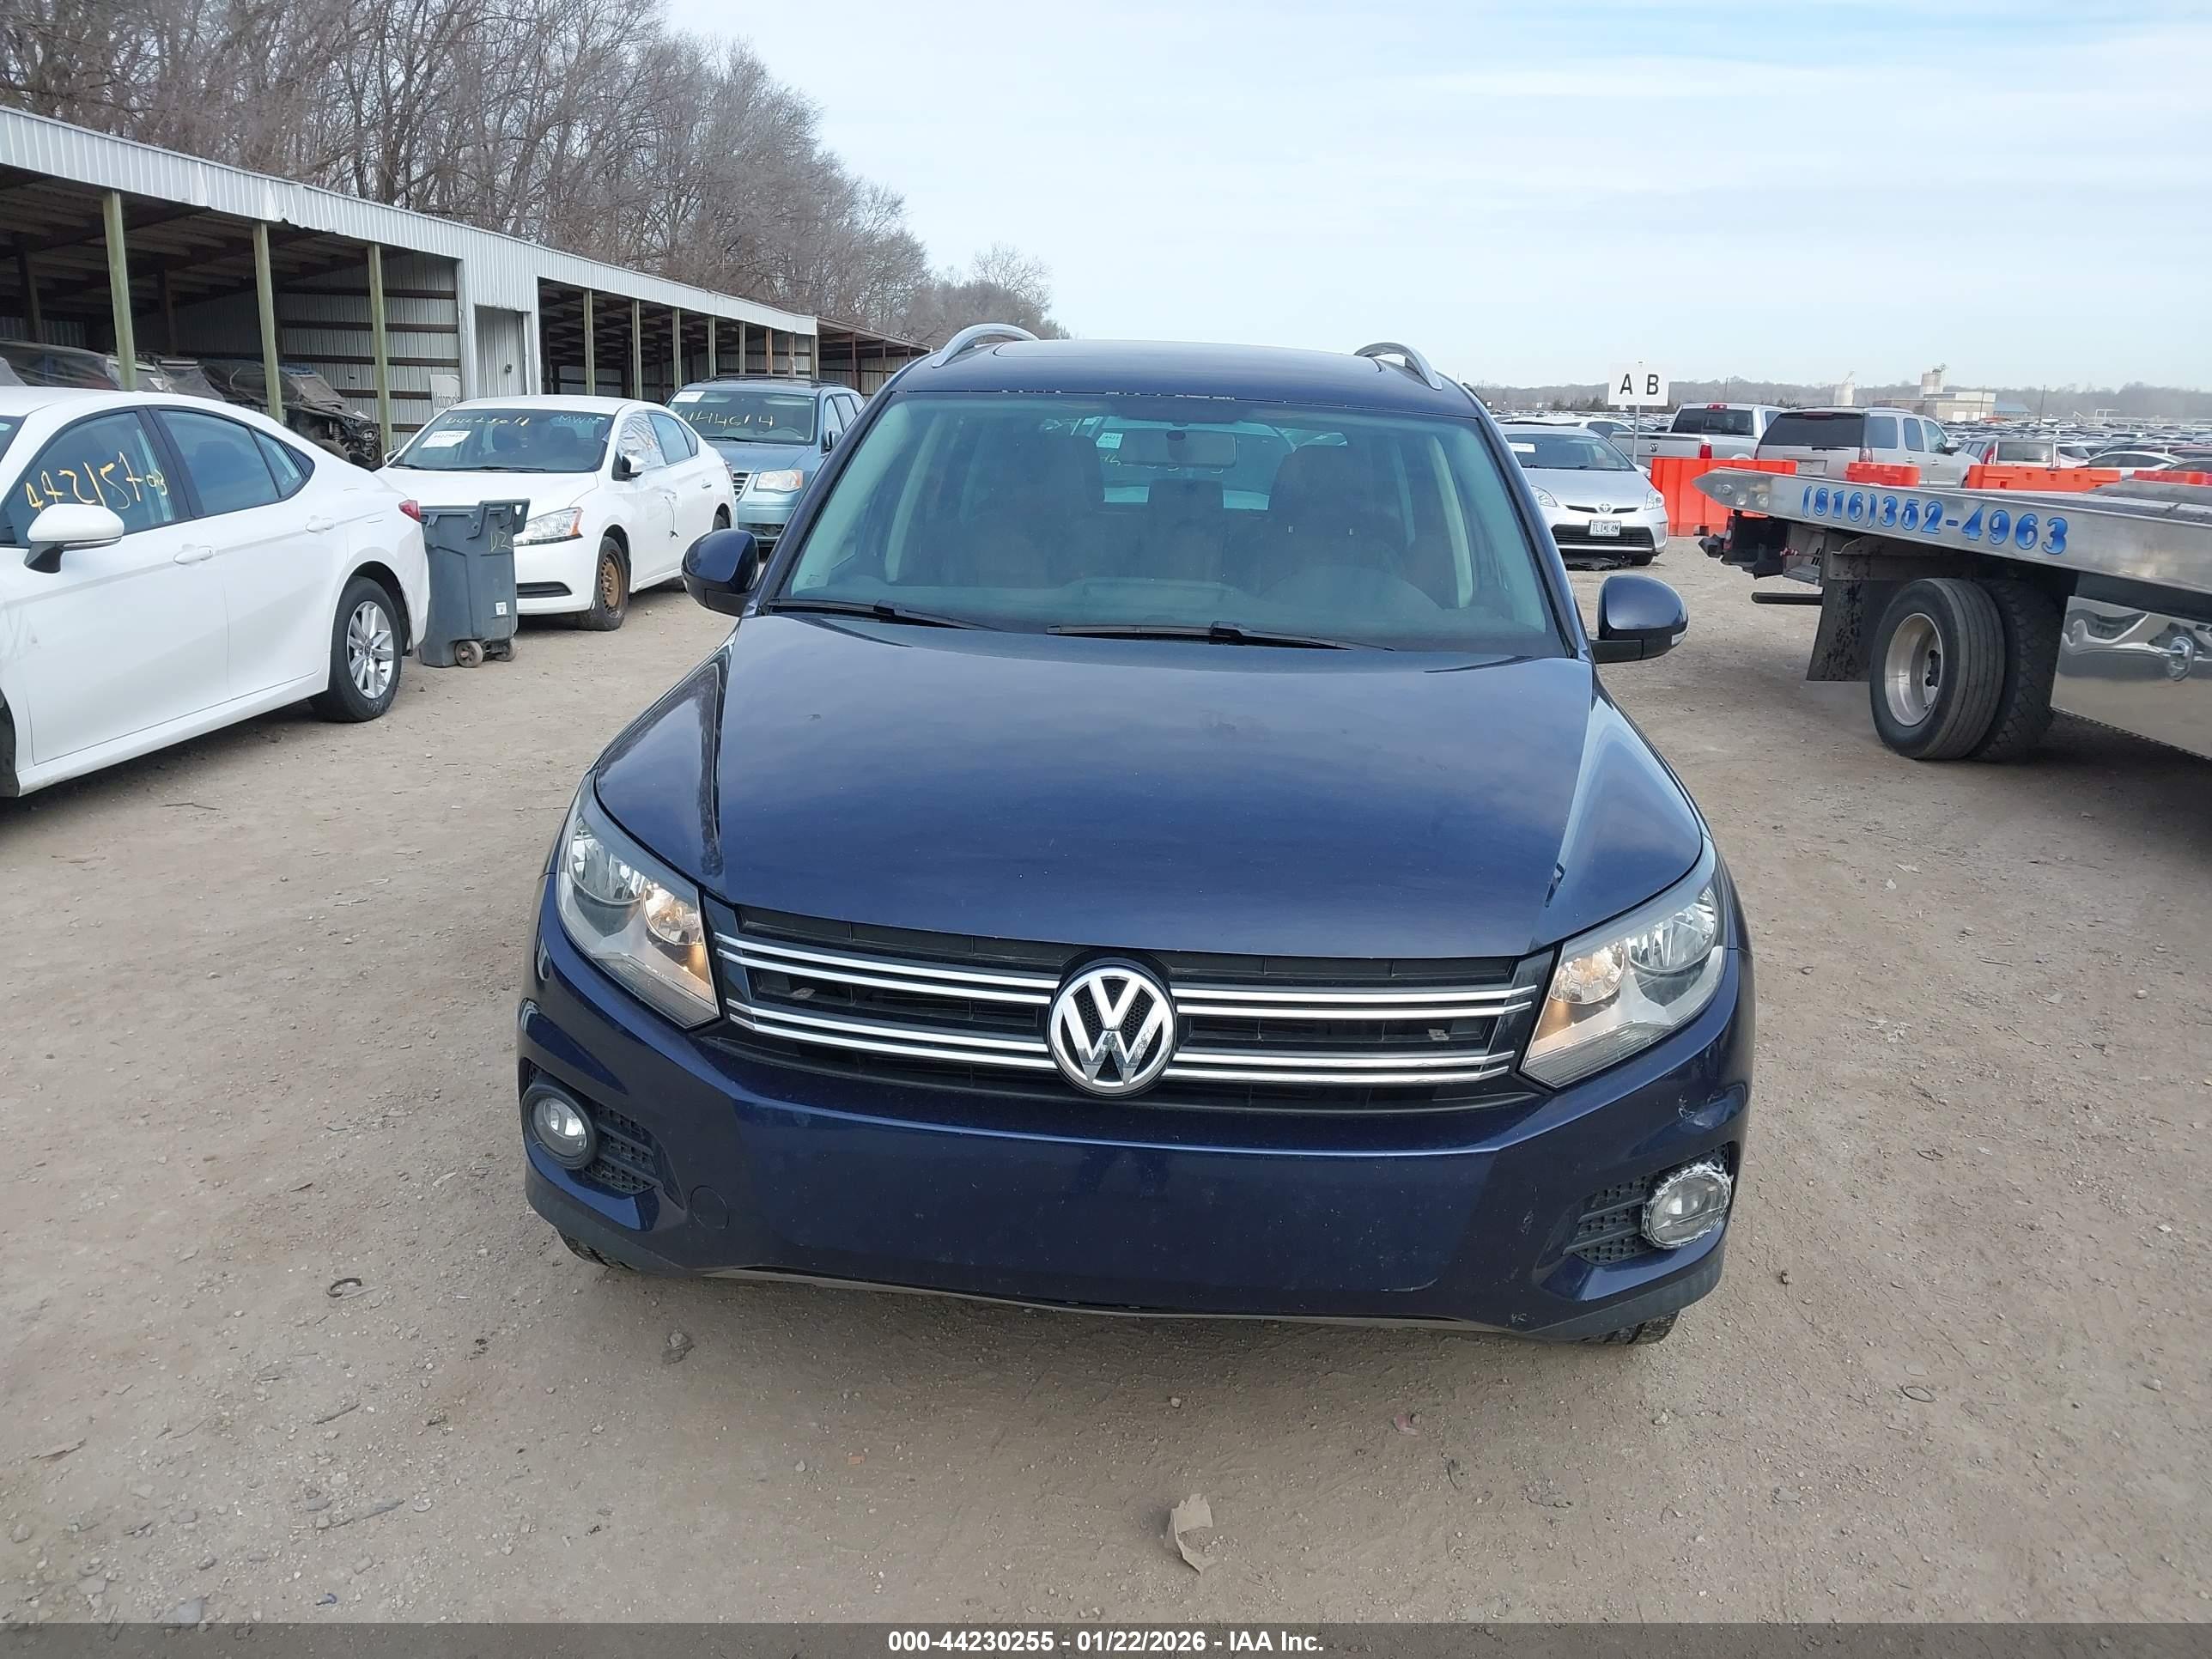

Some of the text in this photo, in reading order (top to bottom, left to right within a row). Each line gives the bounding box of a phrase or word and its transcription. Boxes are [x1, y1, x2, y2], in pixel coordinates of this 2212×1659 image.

[1620, 374, 1659, 395] A B
[1802, 485, 2069, 555] (816)352-4963
